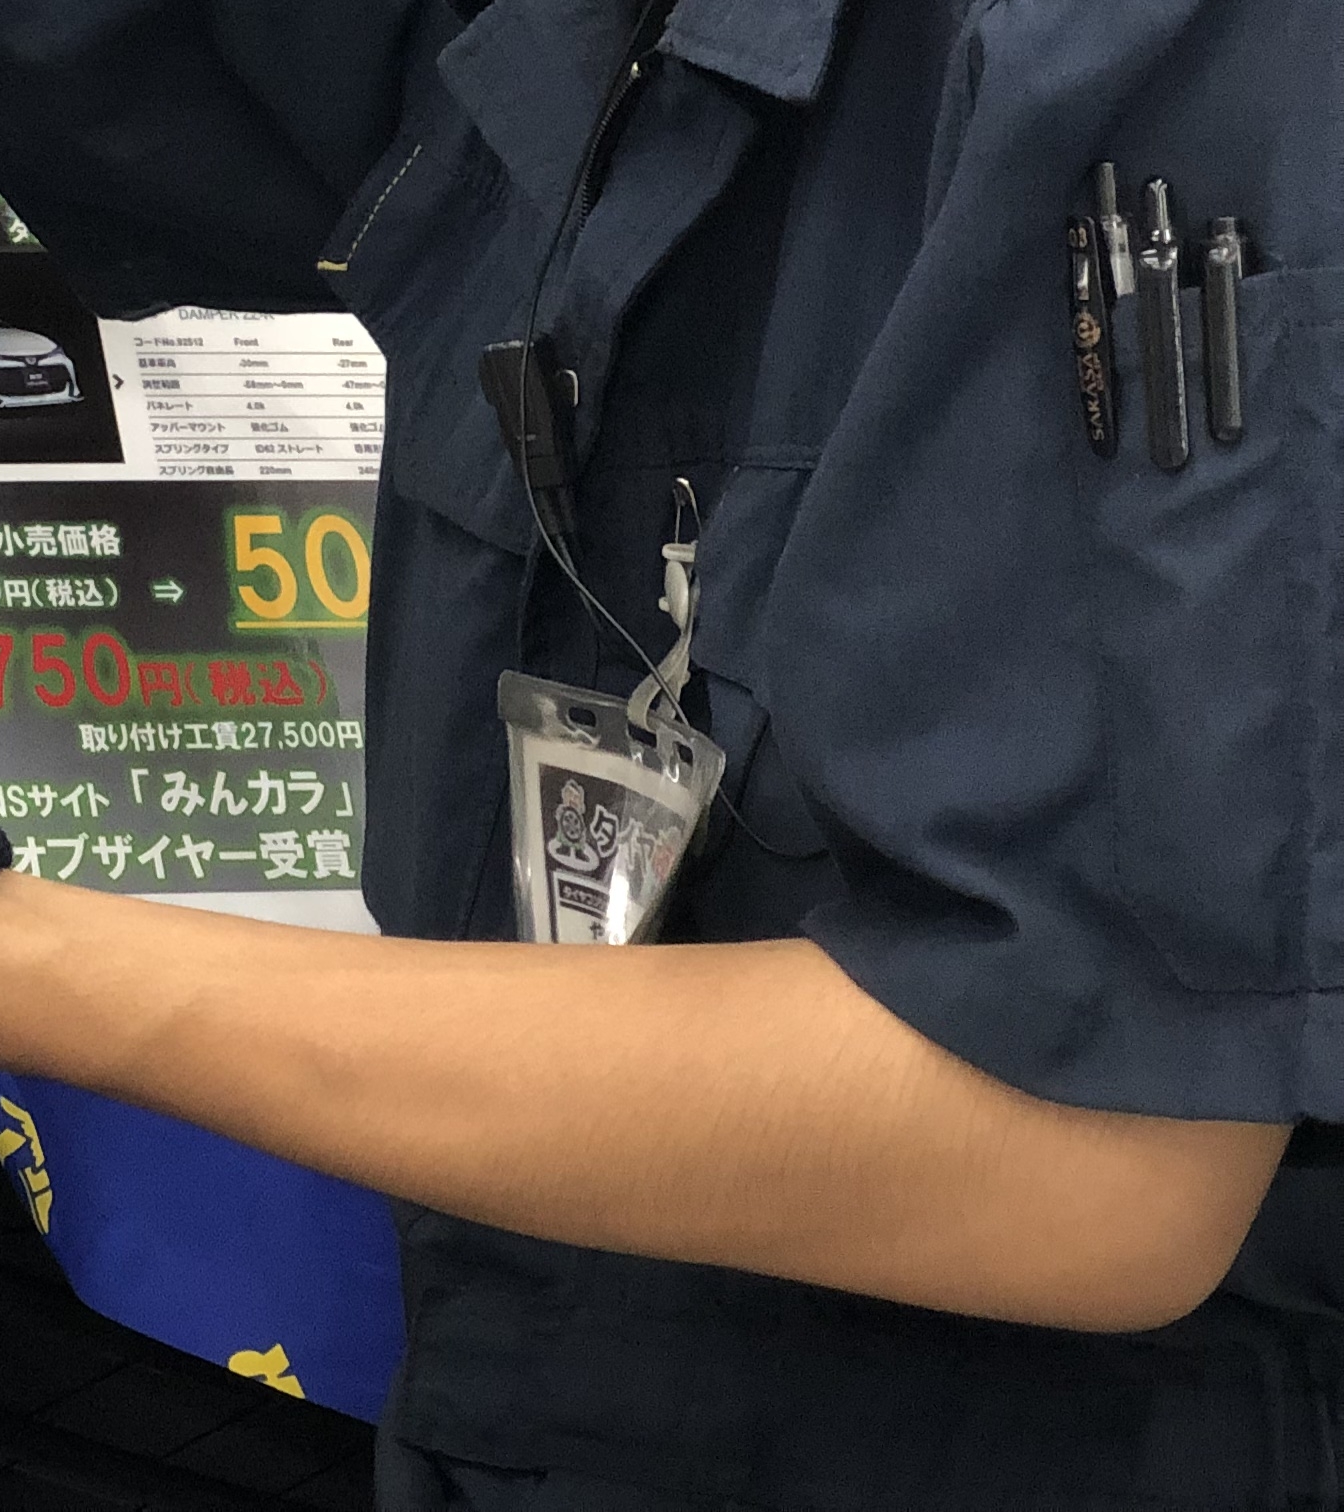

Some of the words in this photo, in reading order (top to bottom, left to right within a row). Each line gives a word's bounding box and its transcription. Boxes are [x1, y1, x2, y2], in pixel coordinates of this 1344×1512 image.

[232, 513, 371, 621] 50
[79, 720, 365, 753] 取り付け工賃27,500円
